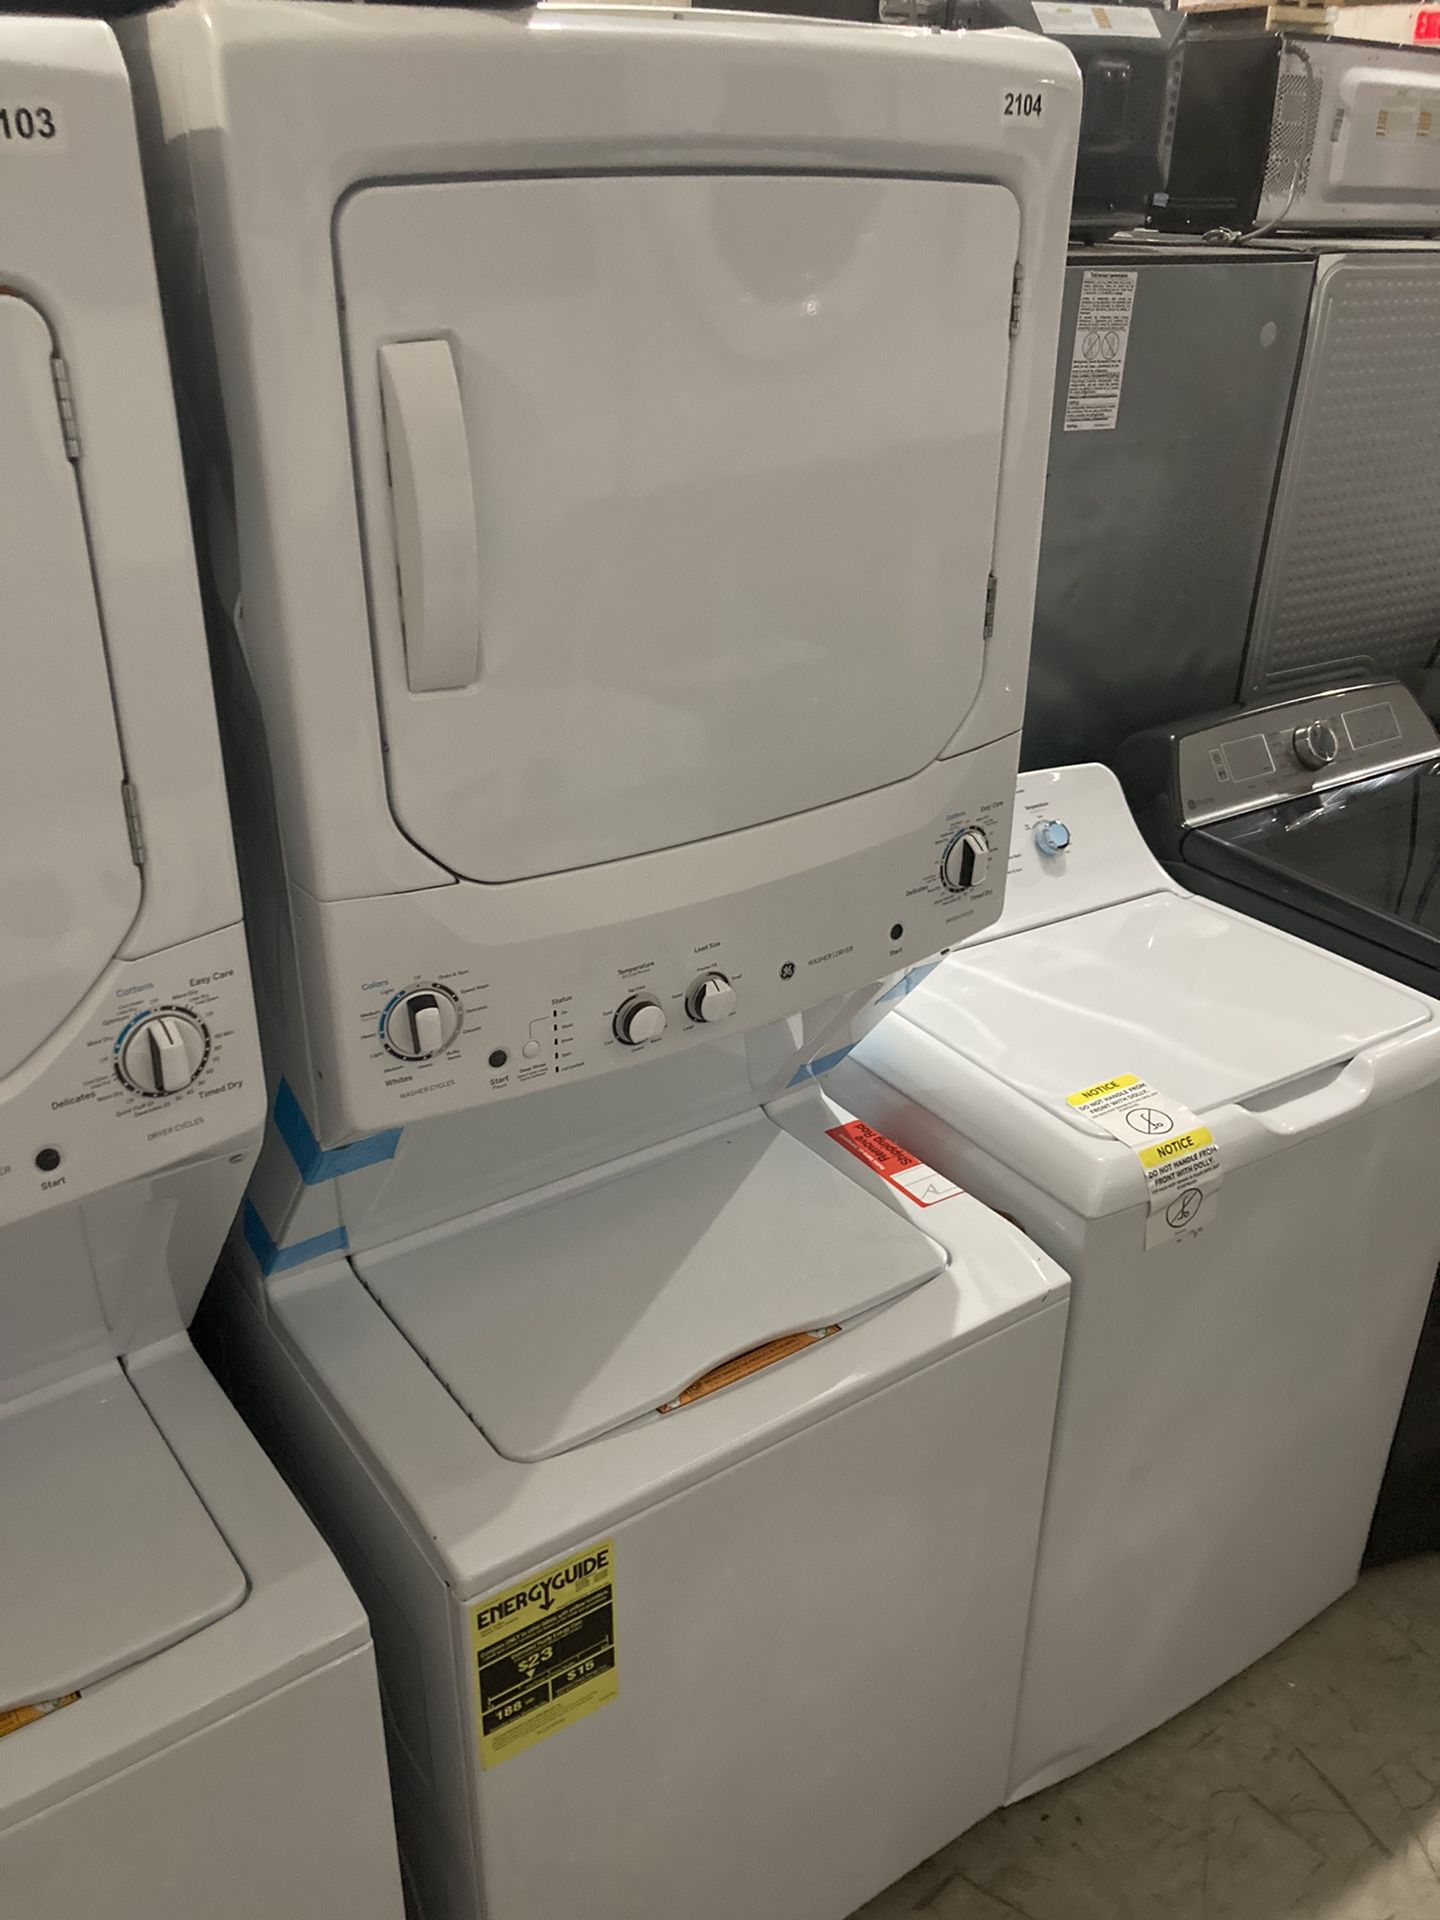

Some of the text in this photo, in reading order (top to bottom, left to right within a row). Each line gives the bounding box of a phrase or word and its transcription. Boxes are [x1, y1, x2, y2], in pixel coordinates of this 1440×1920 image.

[1004, 92, 1042, 117] 2104
[0, 107, 56, 139] 103
[617, 962, 655, 975] Temperature
[189, 969, 234, 988] Easy Care
[361, 980, 389, 991] Colors
[551, 996, 573, 1006] Status
[198, 1080, 243, 1099] Timed Dry
[385, 1075, 413, 1087] Whites
[490, 1075, 508, 1086] Start
[1082, 1081, 1120, 1099] NOTICE
[51, 1092, 96, 1111] Delicates
[1079, 1103, 1090, 1112] DO
[1103, 1090, 1128, 1103] HANDLE
[1127, 1082, 1147, 1094] FROM
[1089, 1104, 1111, 1114] FRONT
[1112, 1097, 1129, 1107] WITH
[147, 1116, 205, 1141] DRYER CYCLES
[854, 1123, 874, 1138] Rod
[854, 1135, 891, 1163] Remove
[873, 1136, 913, 1166] Shipping
[1156, 1135, 1195, 1159] NOTICE
[1148, 1170, 1159, 1180] DO
[1159, 1163, 1173, 1175] NOT
[1173, 1153, 1199, 1170] HANDLE
[1198, 1145, 1218, 1161] FROM
[40, 1176, 66, 1191] Start
[1154, 1173, 1176, 1187] FRONT
[1175, 1167, 1194, 1180] WITH
[476, 1548, 610, 1631] ENERGYGUIDE
[518, 1646, 553, 1673] $23
[567, 1660, 595, 1681] $15
[495, 1701, 522, 1720] 188
